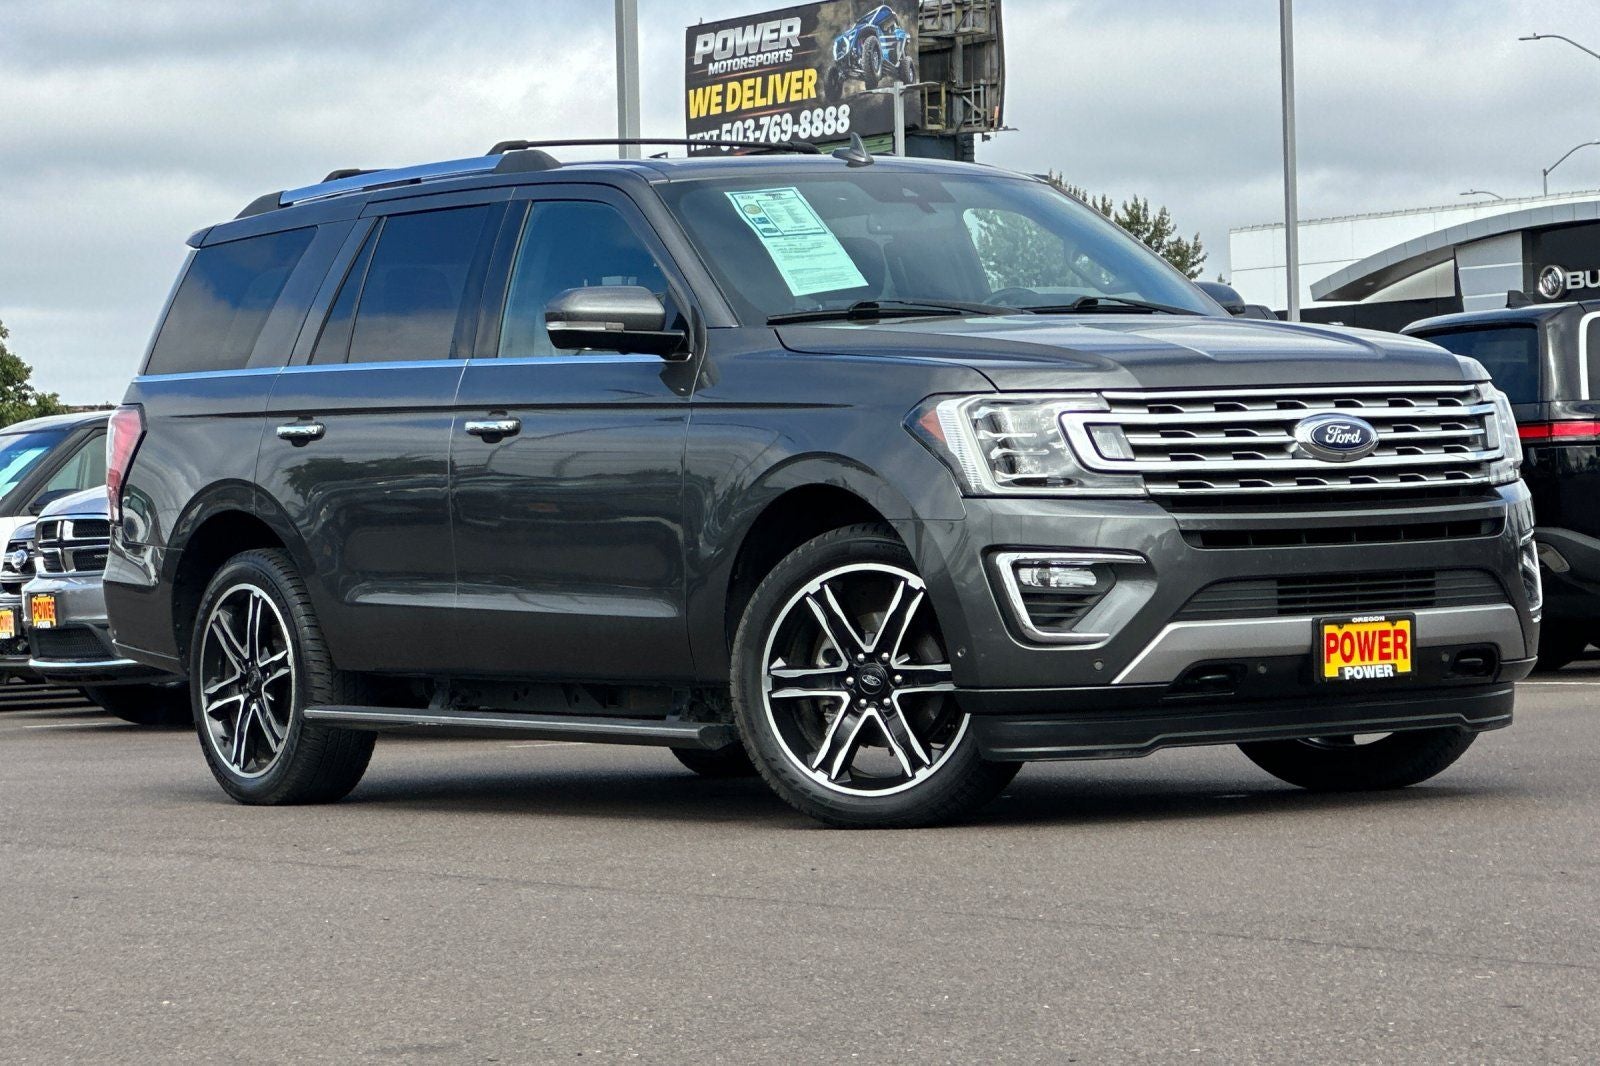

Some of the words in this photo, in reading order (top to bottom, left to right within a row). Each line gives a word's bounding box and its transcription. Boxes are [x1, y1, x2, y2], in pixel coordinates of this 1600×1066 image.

[693, 16, 802, 65] POWER
[707, 48, 794, 77] MOTORSPORTS
[688, 83, 724, 119] WE
[725, 68, 818, 112] DELIVER
[688, 129, 720, 152] TEXT
[720, 103, 851, 152] 503-769-8888
[1325, 424, 1362, 444] Ford
[1351, 615, 1386, 624] OREGON
[1325, 628, 1409, 665] POWER
[1343, 664, 1394, 680] POWER
